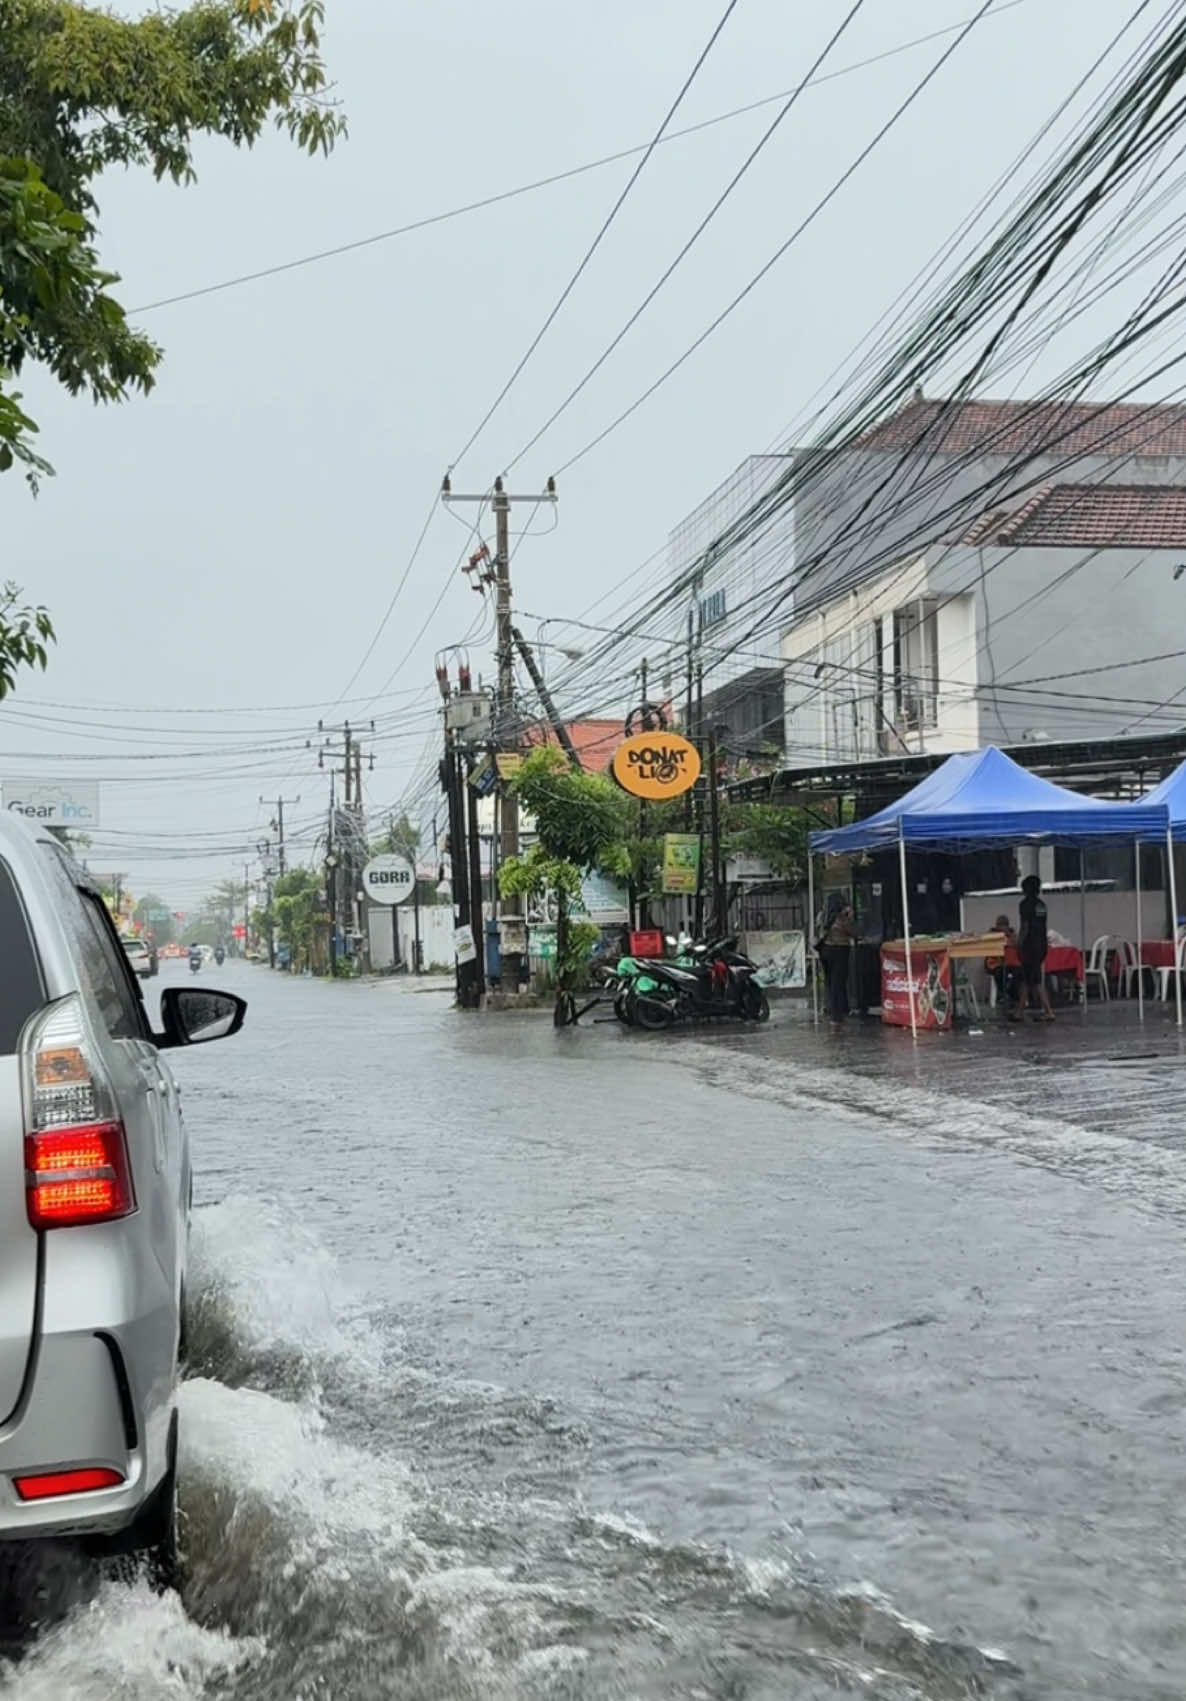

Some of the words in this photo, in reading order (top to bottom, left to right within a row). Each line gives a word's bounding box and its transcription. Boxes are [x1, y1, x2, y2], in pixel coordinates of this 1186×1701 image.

[628, 746, 688, 765] DONAT
[7, 800, 56, 818] Gear
[369, 871, 410, 884] GORA
